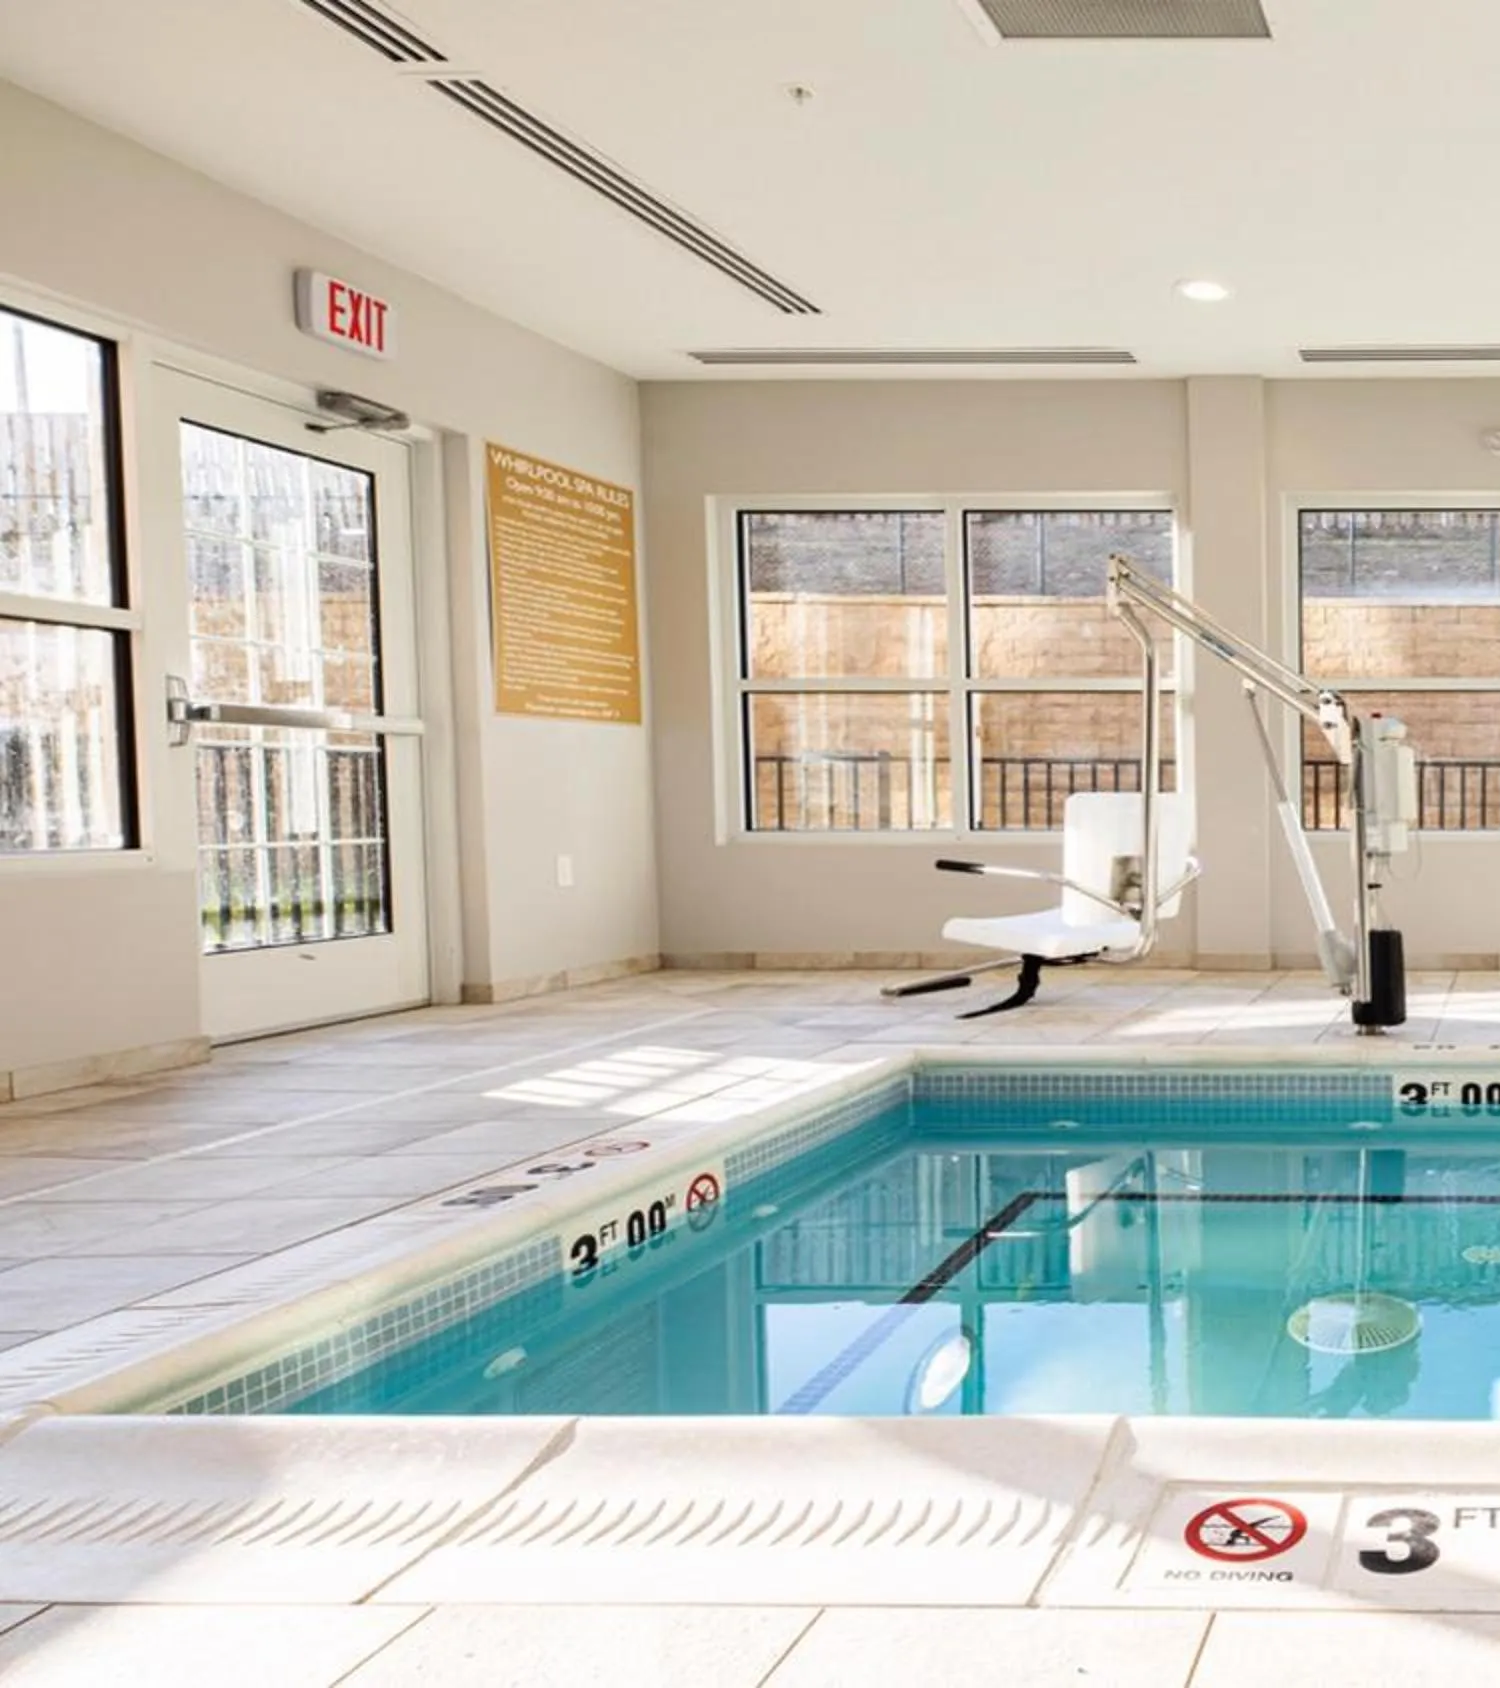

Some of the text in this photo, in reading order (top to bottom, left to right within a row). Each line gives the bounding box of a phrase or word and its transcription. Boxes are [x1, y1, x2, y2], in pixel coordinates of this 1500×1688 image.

[330, 281, 387, 352] EXIT
[490, 448, 630, 508] WHIRLPOOL SPA RULES
[1431, 1082, 1451, 1095] FT
[571, 1234, 599, 1276] 3
[600, 1219, 618, 1246] FT
[1359, 1508, 1440, 1575] 3
[1164, 1570, 1294, 1582] NO DIVING
